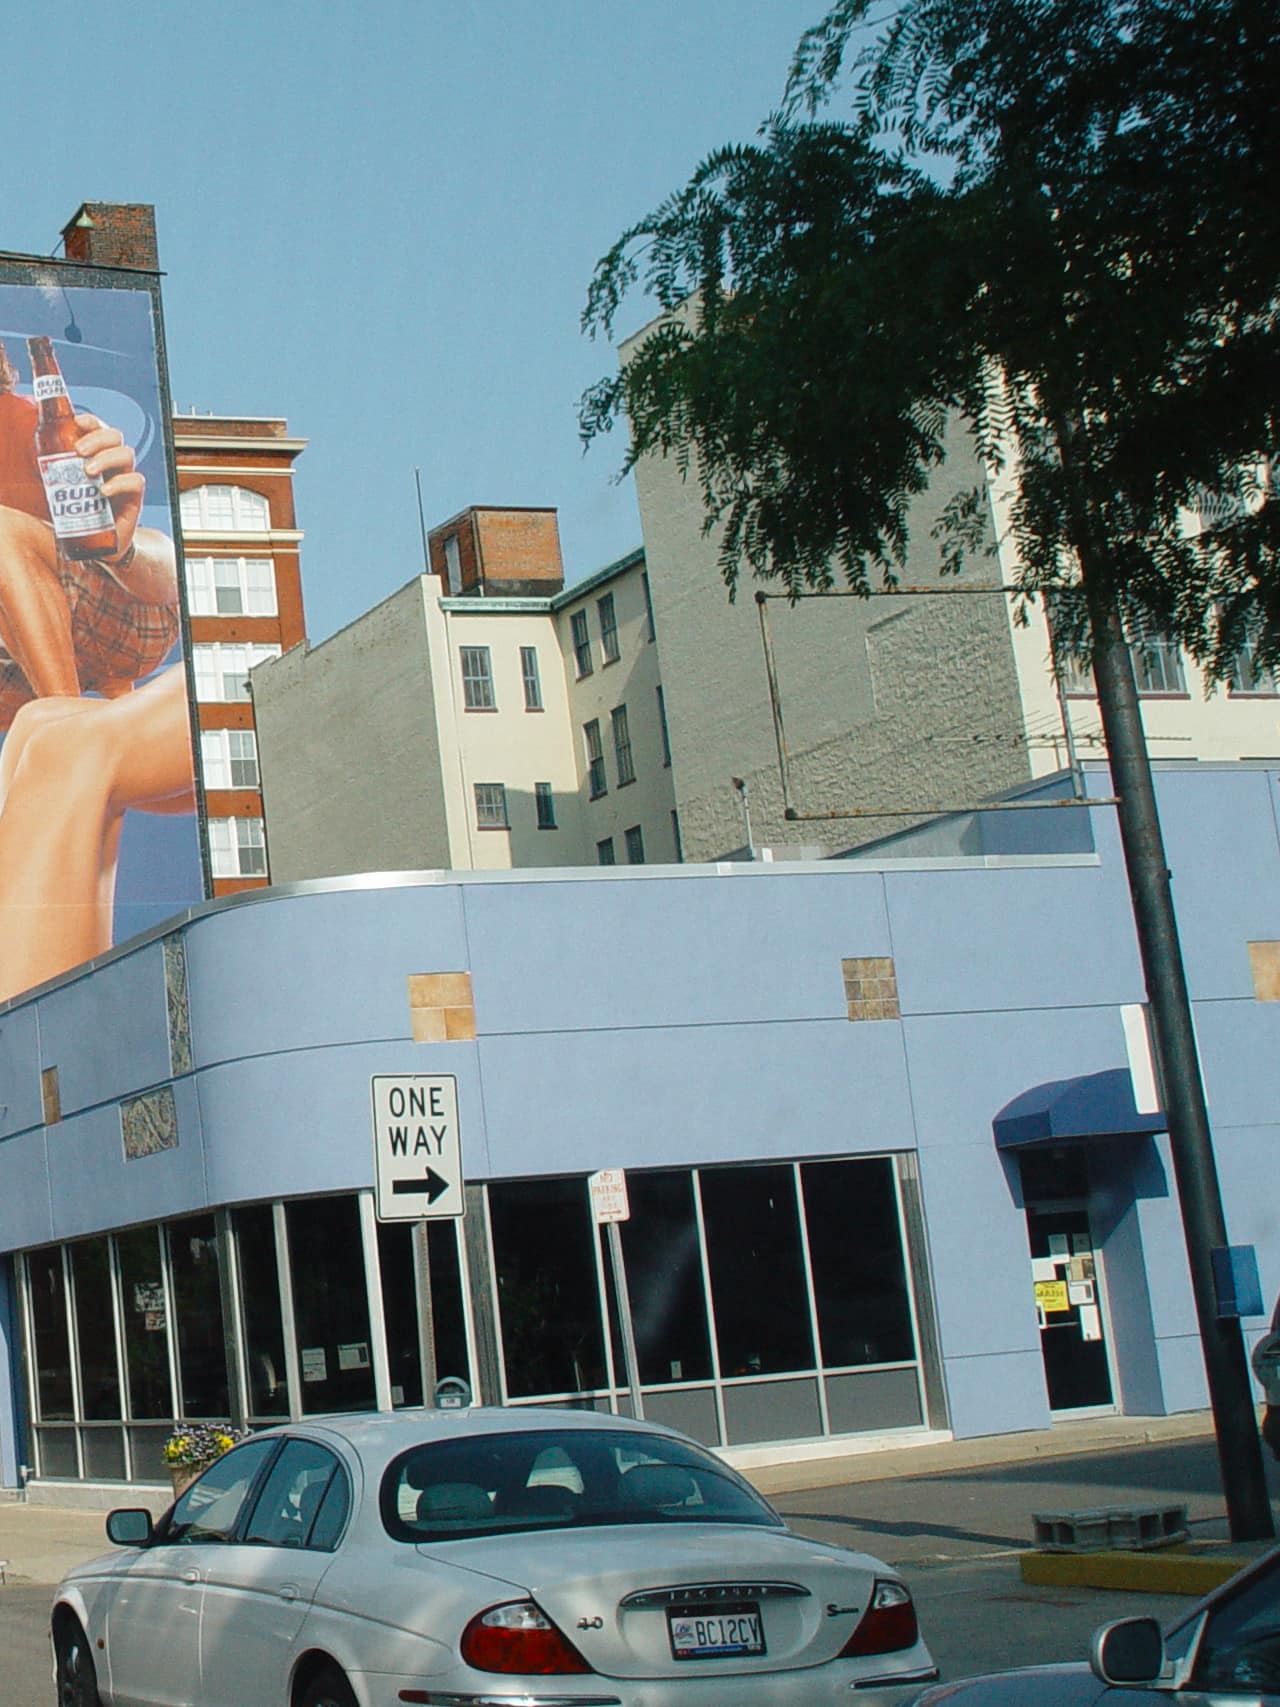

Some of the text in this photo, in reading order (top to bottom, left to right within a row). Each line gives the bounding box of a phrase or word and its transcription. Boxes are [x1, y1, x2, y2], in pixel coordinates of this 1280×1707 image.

[54, 485, 100, 502] BUD
[389, 1087, 444, 1117] ONE
[388, 1125, 447, 1156] WAY
